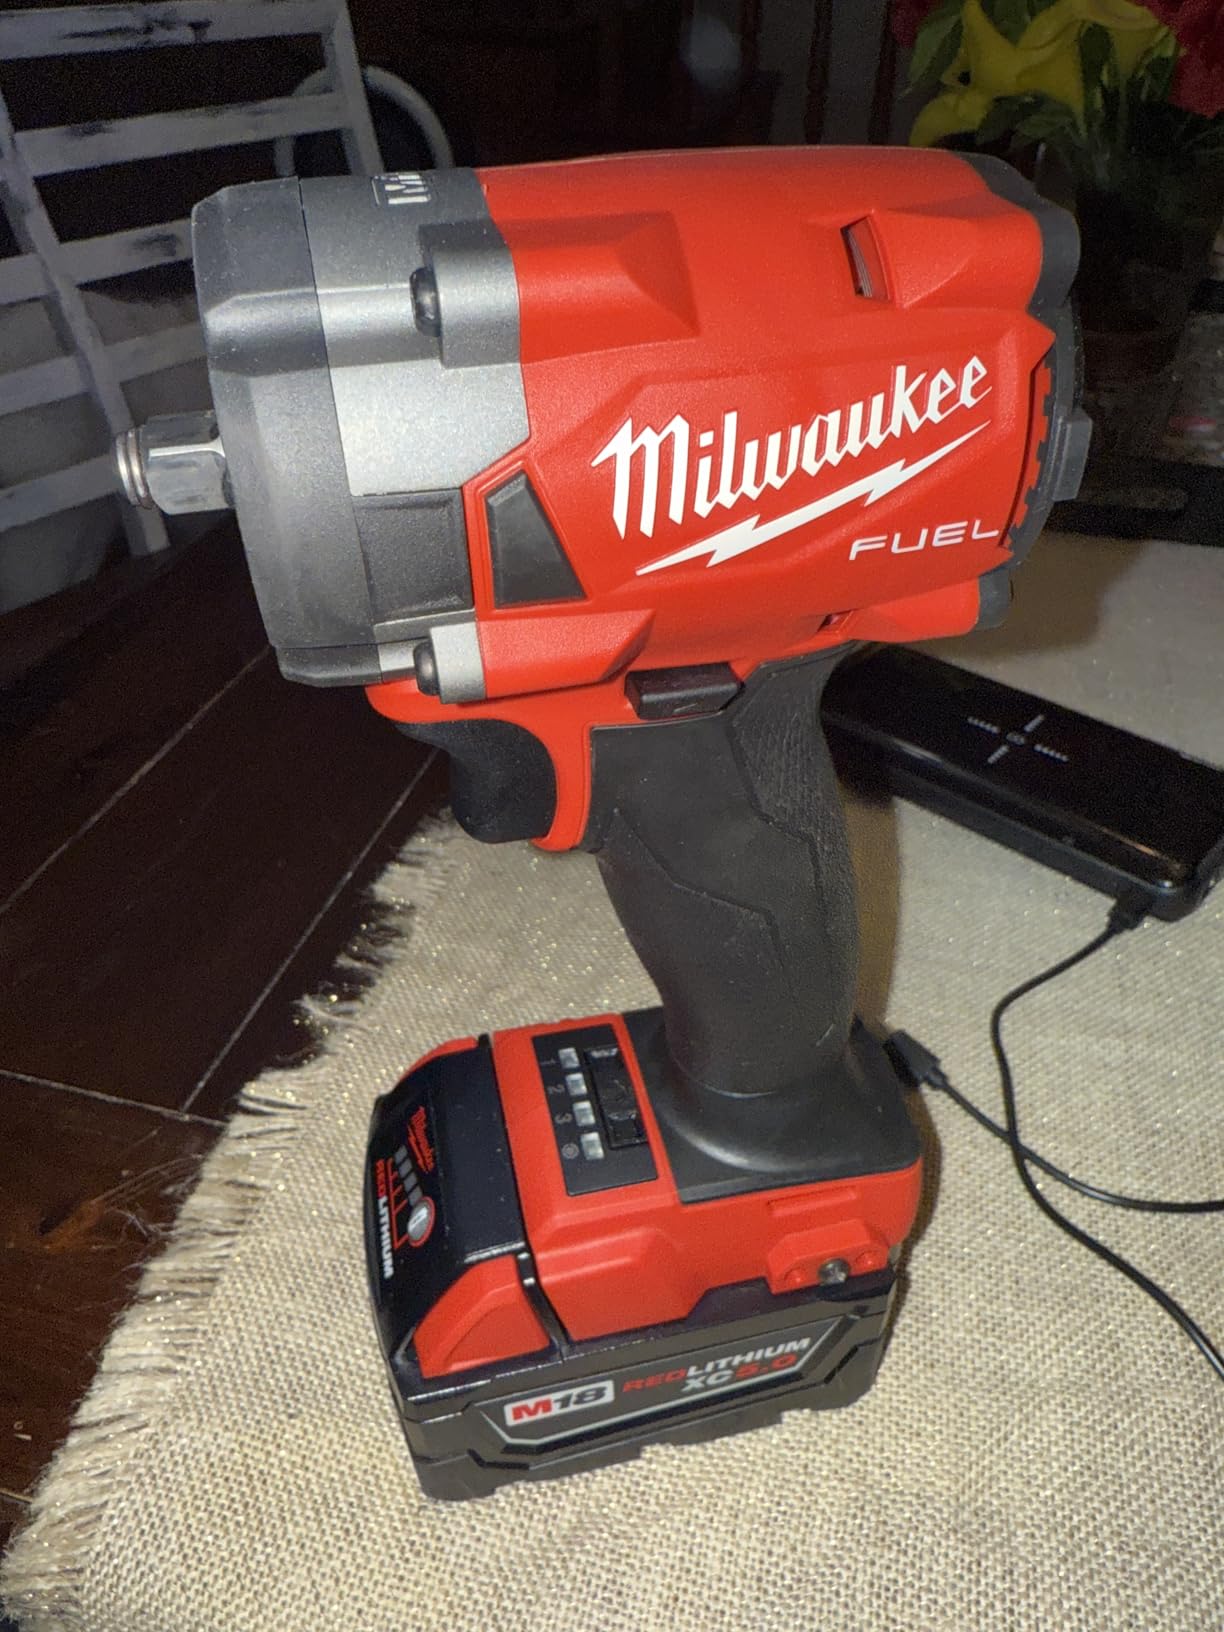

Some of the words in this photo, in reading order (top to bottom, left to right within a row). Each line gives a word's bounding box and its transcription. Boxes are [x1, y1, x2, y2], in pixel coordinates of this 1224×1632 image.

[591, 355, 993, 539] Milwaukee
[848, 518, 999, 561] FUEL
[511, 1386, 608, 1421] M18
[622, 1337, 811, 1393] REDLITHIUM
